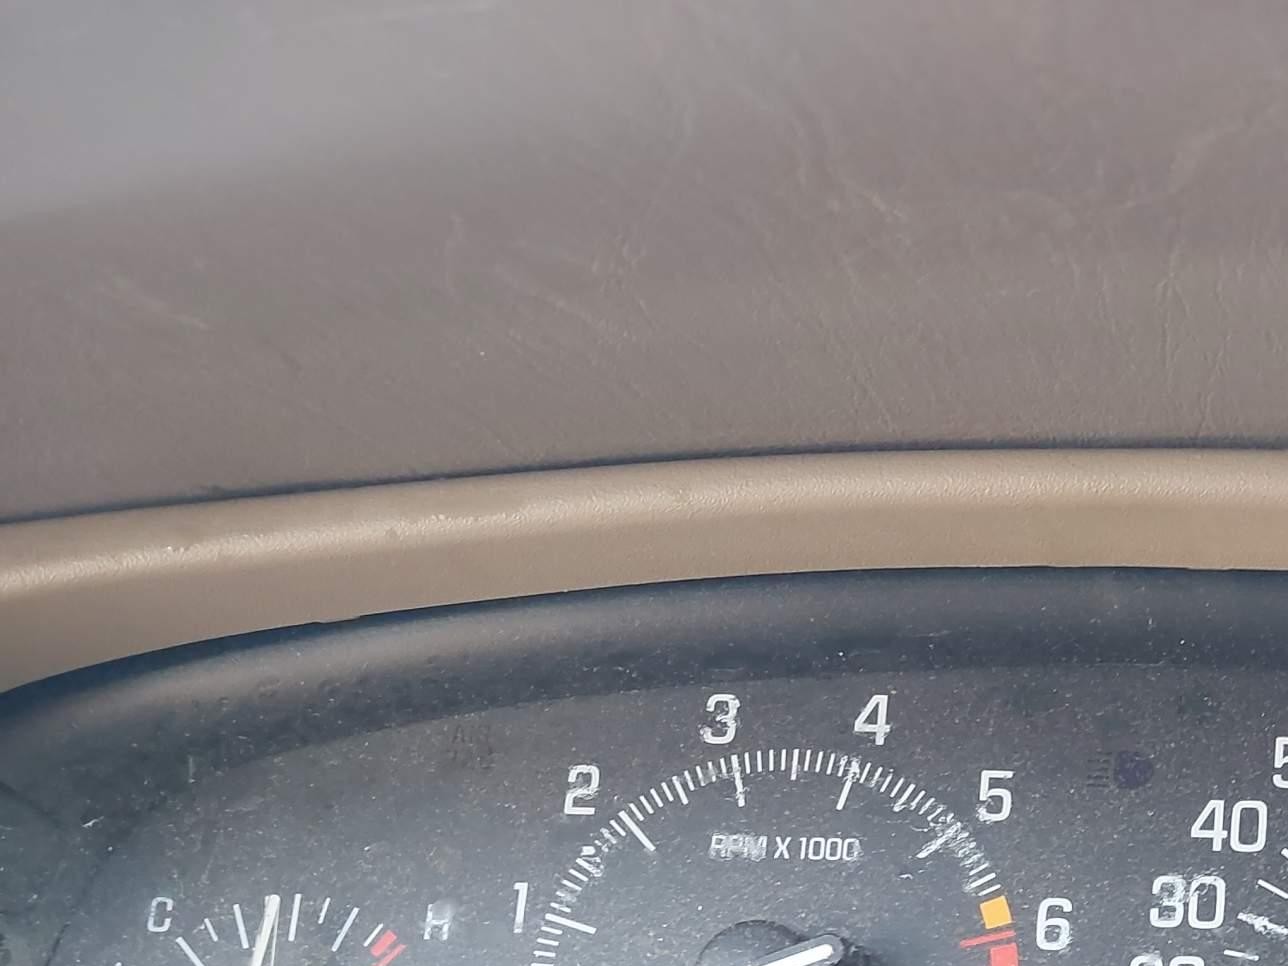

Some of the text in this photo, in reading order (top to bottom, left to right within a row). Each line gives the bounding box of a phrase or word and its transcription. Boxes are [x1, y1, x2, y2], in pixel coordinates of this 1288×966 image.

[702, 694, 740, 744] 3
[854, 695, 891, 745] 4
[564, 765, 600, 815] 2
[979, 770, 1013, 821] 5
[710, 834, 862, 862] RPM X 1000
[1190, 800, 1267, 853] 40
[148, 898, 173, 933] C
[514, 883, 528, 932] 1
[1035, 898, 1074, 951] 6
[1150, 877, 1225, 929] 30
